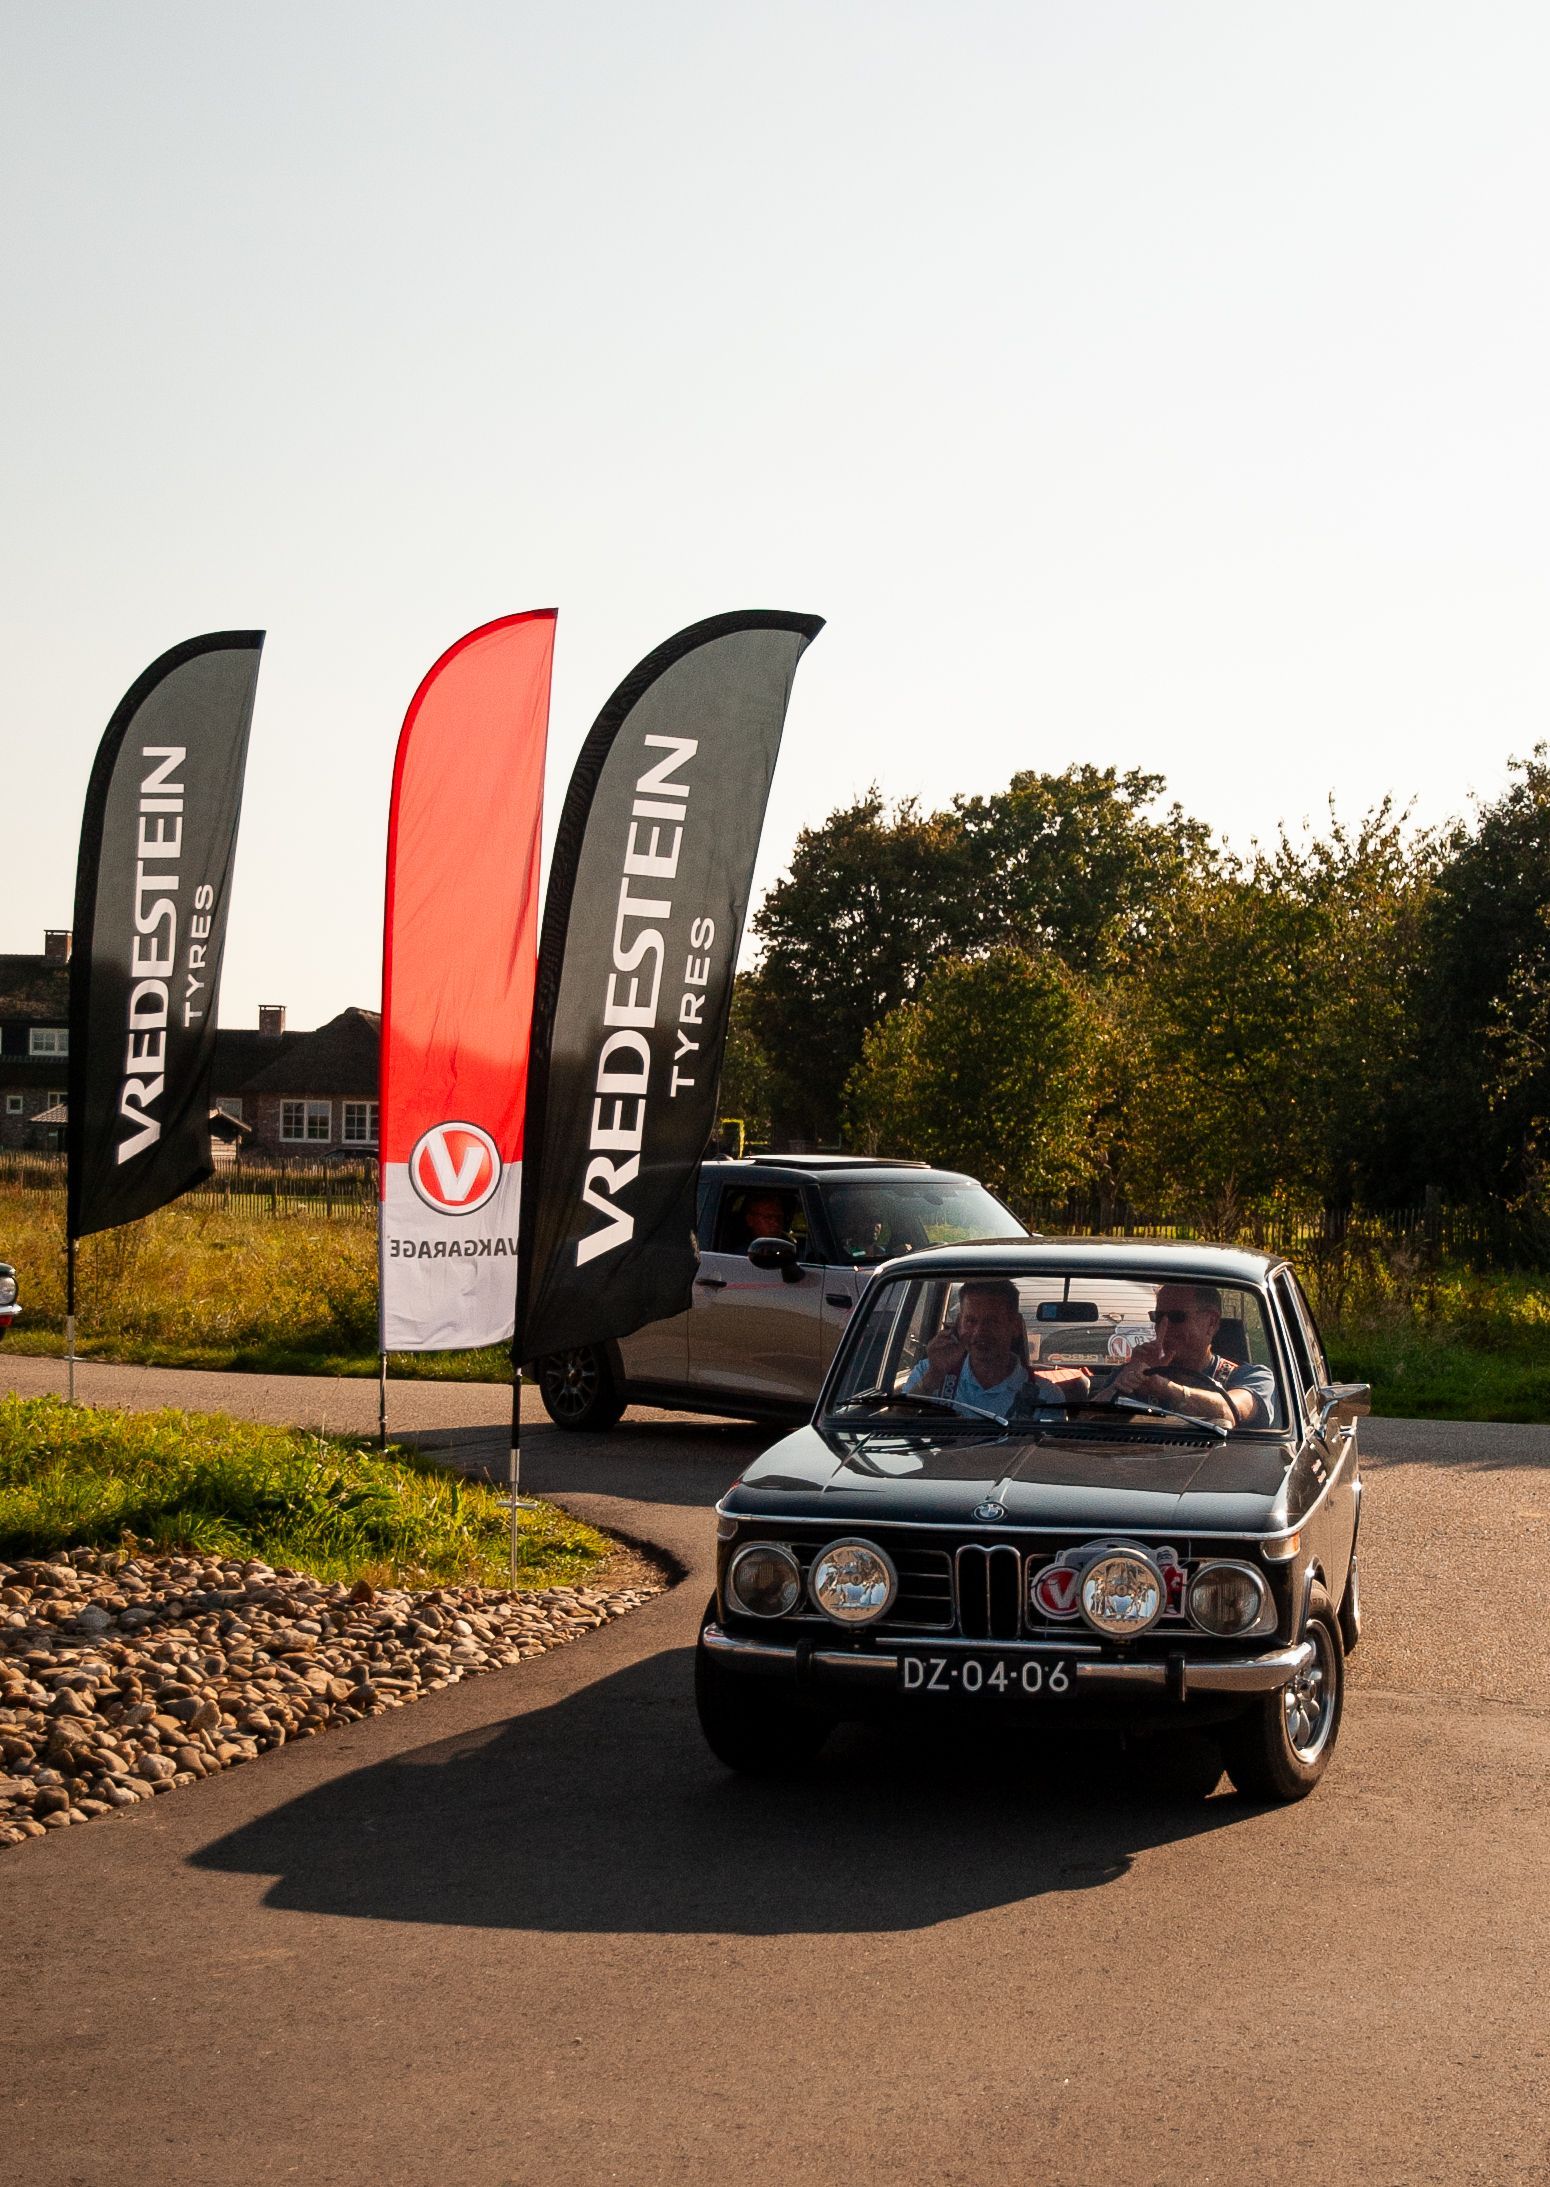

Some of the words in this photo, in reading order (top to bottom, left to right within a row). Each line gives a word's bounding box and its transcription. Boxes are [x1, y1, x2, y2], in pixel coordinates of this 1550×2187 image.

[117, 745, 187, 1166] VREDESTEIN
[184, 884, 214, 1029] TYRES
[576, 733, 700, 1268] VREDESTEIN
[670, 916, 715, 1098] TYRES
[904, 1657, 1069, 1692] DZ-04-06
